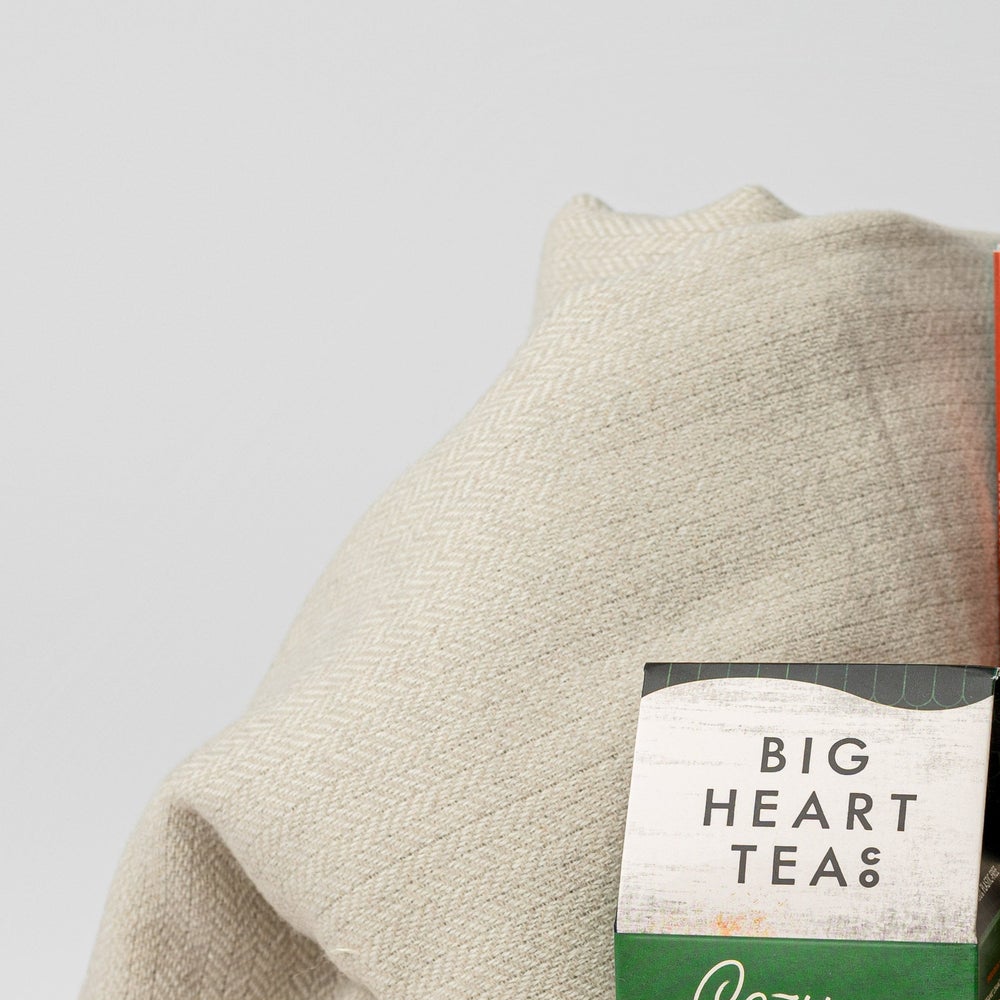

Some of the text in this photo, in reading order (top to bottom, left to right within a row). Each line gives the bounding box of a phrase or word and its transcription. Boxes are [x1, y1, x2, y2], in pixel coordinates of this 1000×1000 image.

[760, 736, 869, 776] BIG
[703, 788, 918, 832] HEART
[731, 844, 848, 888] TEA
